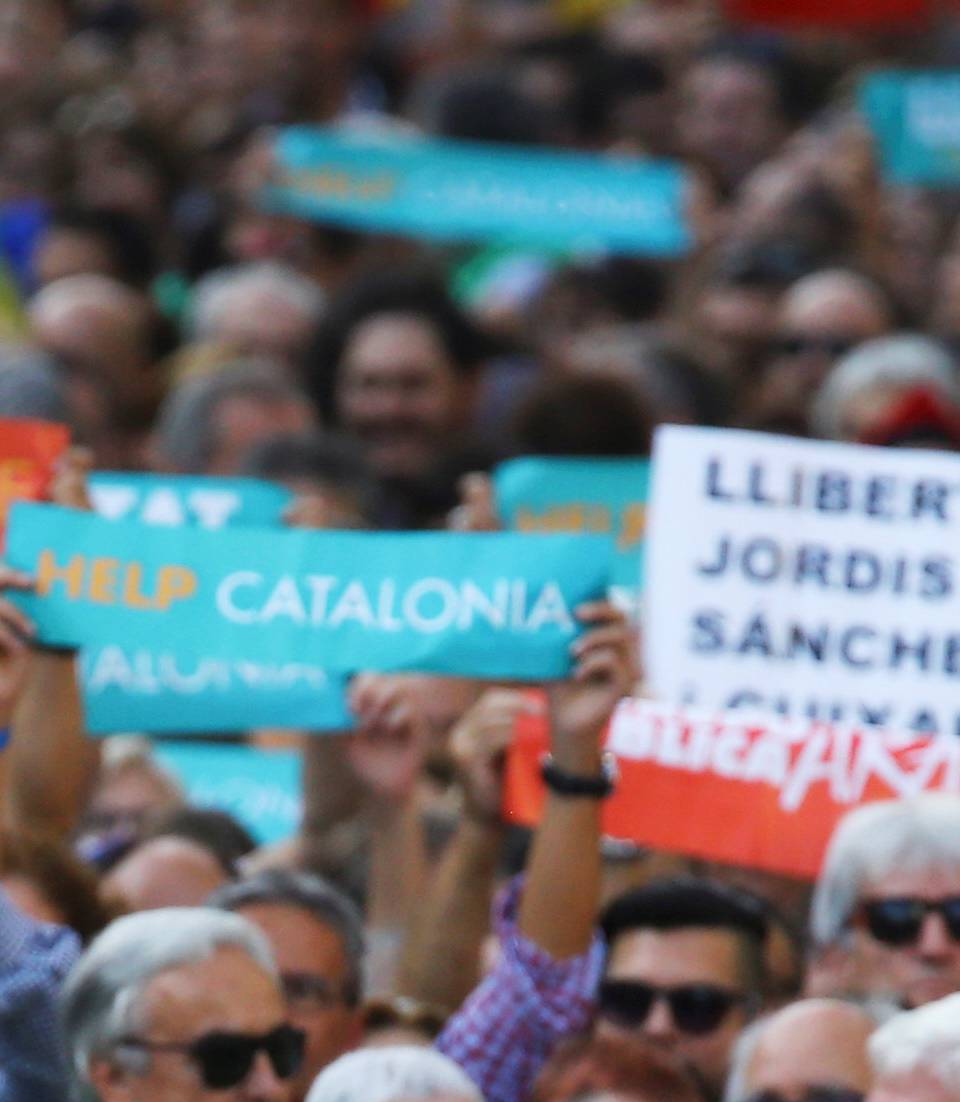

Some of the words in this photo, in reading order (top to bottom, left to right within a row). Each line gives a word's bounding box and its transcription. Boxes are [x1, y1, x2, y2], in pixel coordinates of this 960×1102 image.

[704, 457, 952, 522] LLIBER
[36, 548, 198, 613] HELP
[214, 570, 576, 634] CATALONIA
[695, 535, 953, 600] JORDIS
